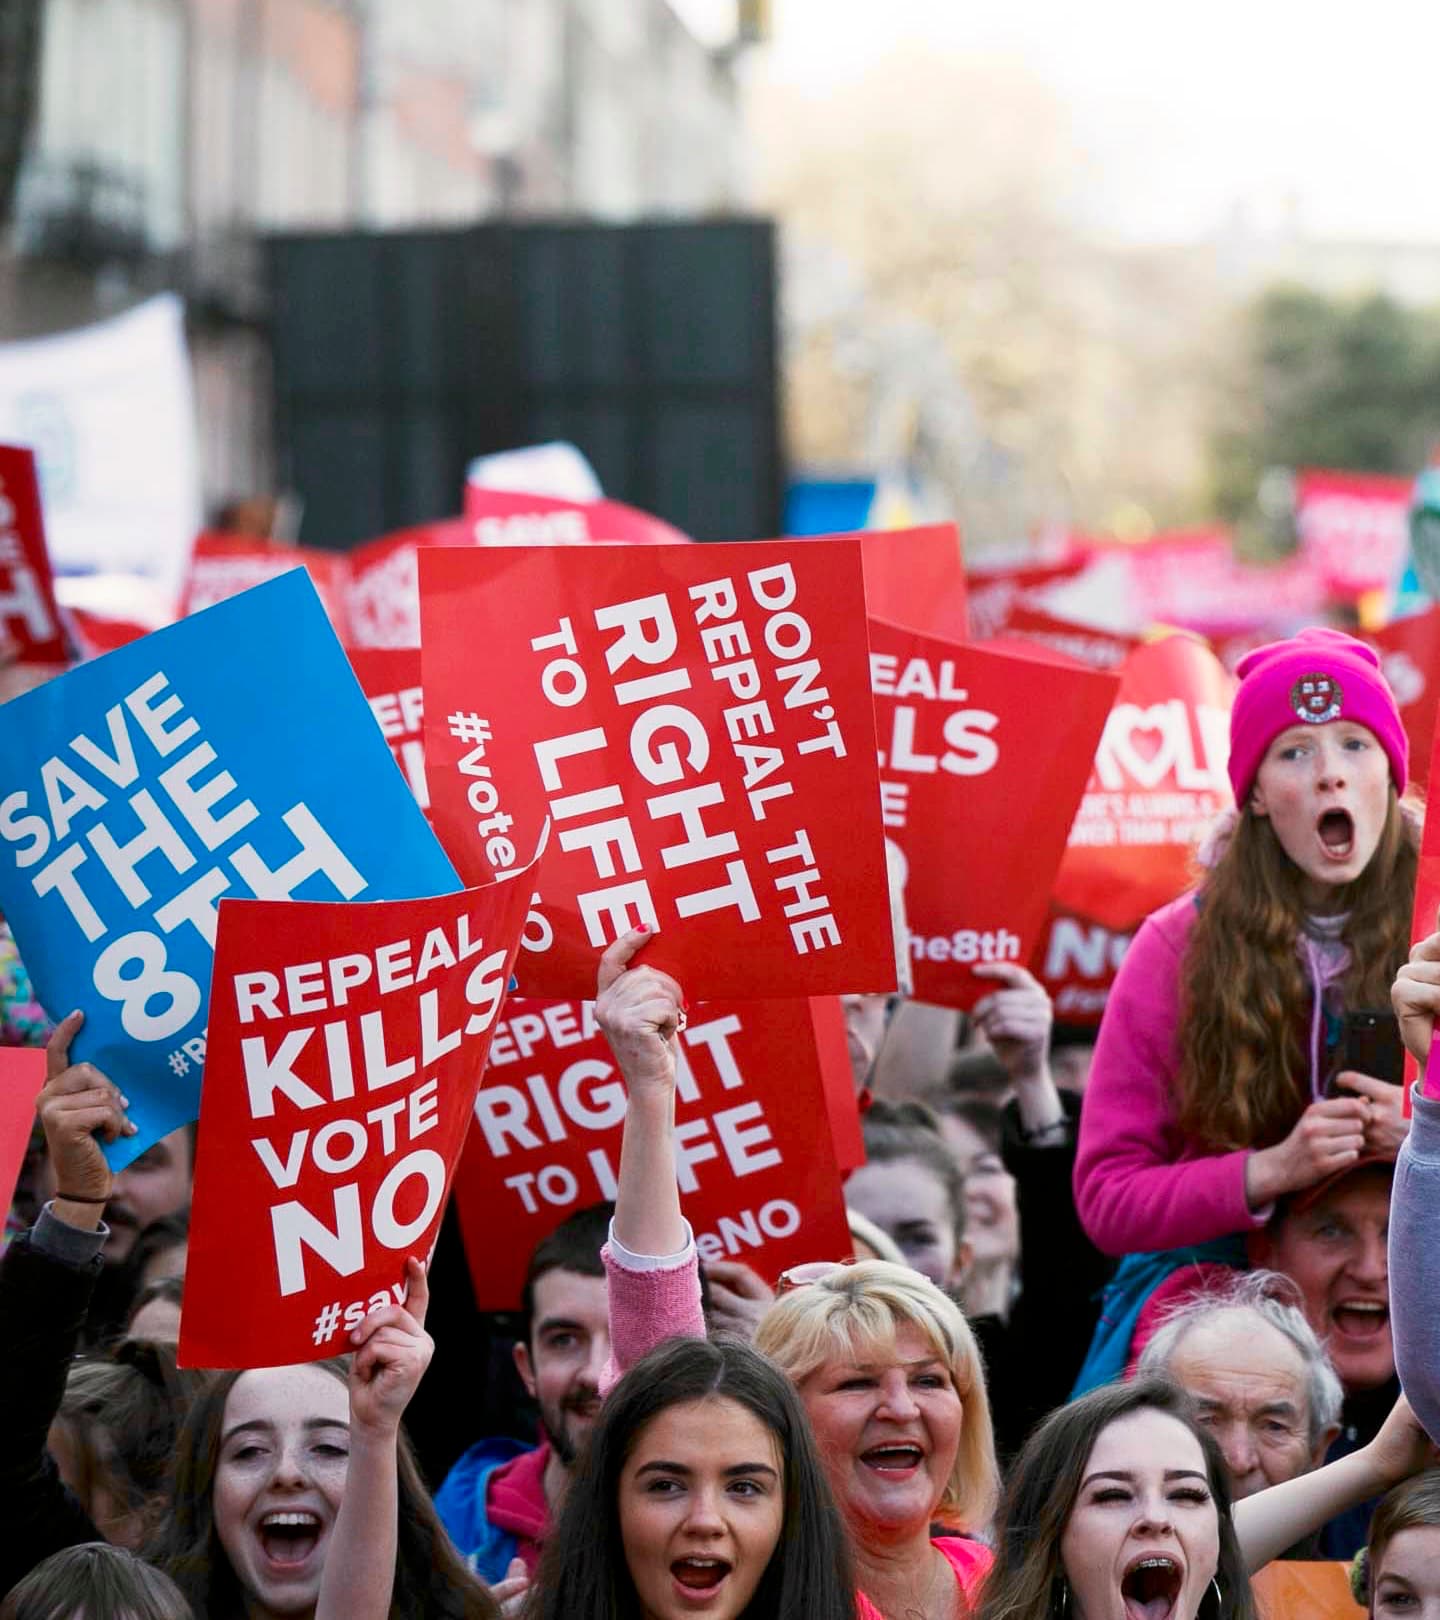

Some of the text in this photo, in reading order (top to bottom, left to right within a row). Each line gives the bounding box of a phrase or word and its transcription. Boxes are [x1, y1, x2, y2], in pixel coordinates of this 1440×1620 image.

[594, 592, 762, 924] RIGHT
[748, 562, 848, 760] DON'T
[0, 671, 201, 868] SAVE
[31, 740, 261, 943] THE
[530, 616, 661, 948] TO LIFE
[688, 577, 842, 955] REPEAL THE
[93, 801, 370, 1042] 8TH
[233, 913, 484, 1024] REPEAL
[240, 947, 509, 1119] KILLS
[251, 1078, 440, 1189] VOTE
[269, 1147, 447, 1298] NO
[503, 1164, 579, 1215] TO
